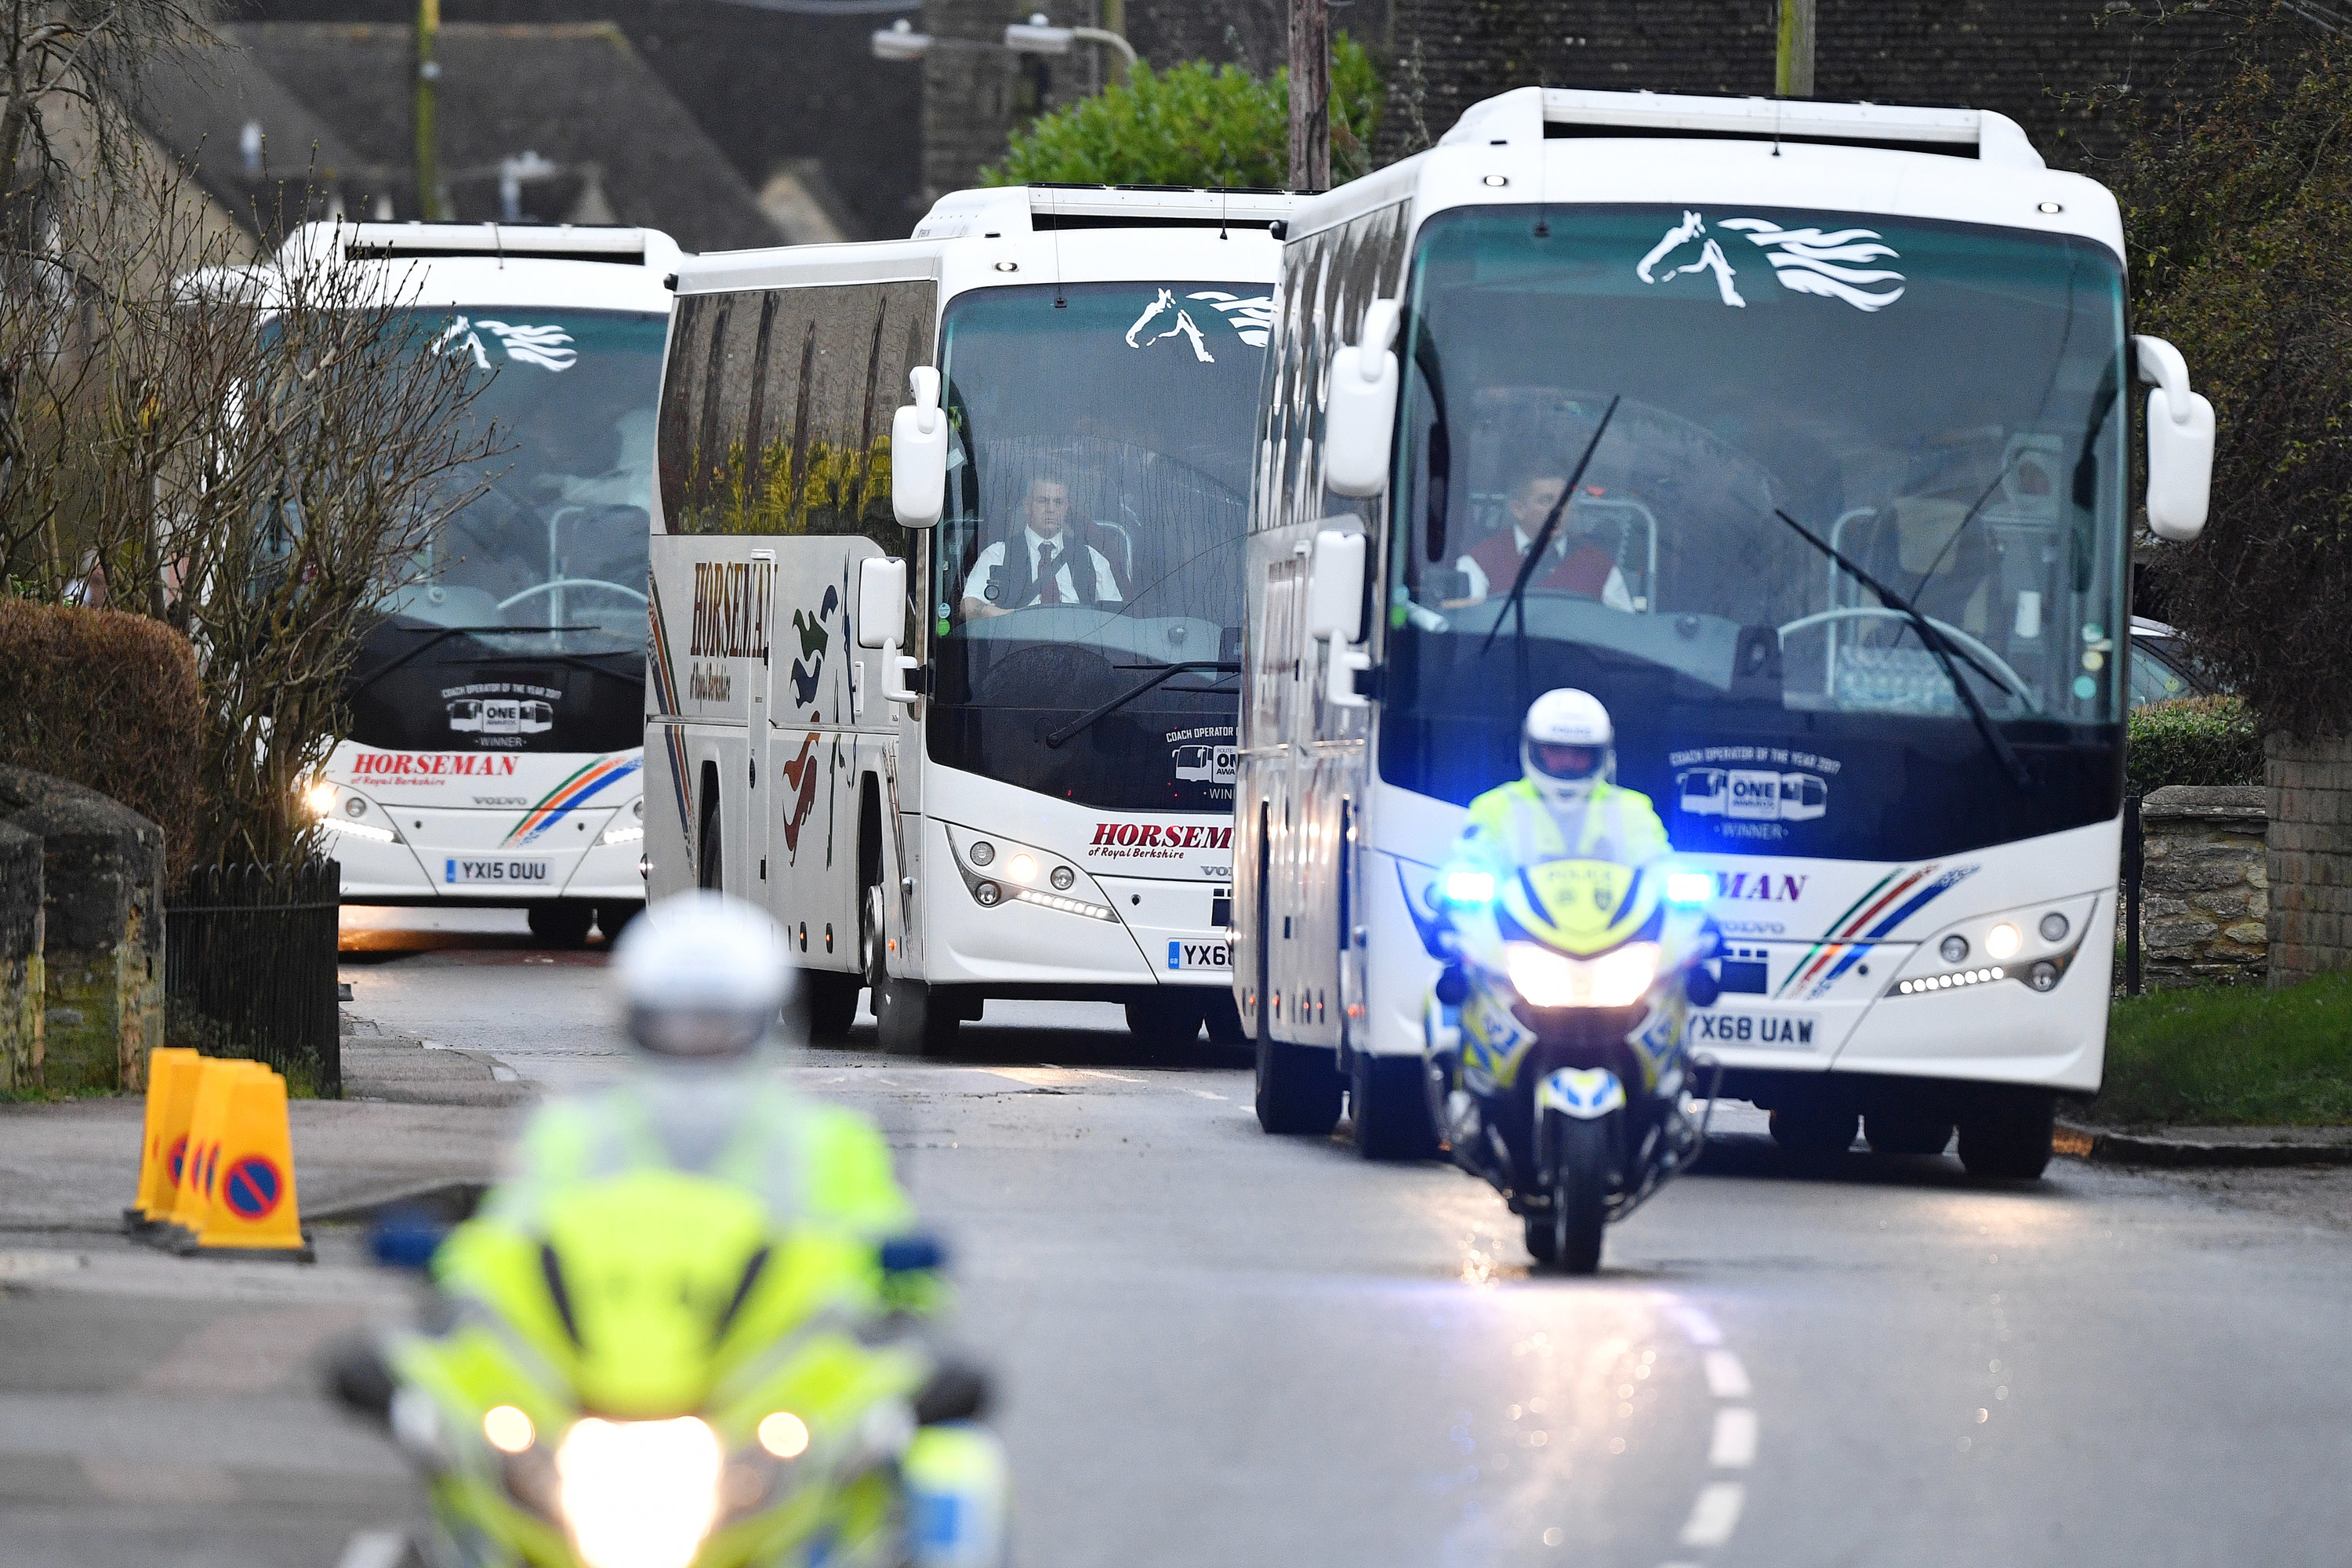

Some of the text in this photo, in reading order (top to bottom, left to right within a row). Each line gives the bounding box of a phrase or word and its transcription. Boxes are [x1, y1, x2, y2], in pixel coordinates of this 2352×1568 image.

[442, 686, 466, 698] COACH
[466, 684, 500, 695] OPERATOR
[502, 683, 510, 692] OF
[513, 684, 524, 693] THE
[527, 685, 545, 695] YEAR
[487, 707, 516, 718] ONE
[480, 737, 523, 747] WINNER
[1166, 729, 1192, 743] COACH
[1194, 727, 1233, 738] OPERATOR
[351, 753, 520, 776] HORSEMAN
[350, 776, 445, 786] of Royal Berkshire
[1209, 788, 1234, 800] WIN
[1733, 781, 1775, 797] ONE
[473, 796, 528, 805] VOLVO
[1090, 823, 1233, 849] HORSEM
[1723, 822, 1782, 840] WINNER
[1088, 848, 1185, 859] of Royal Berkshire
[463, 862, 546, 880] YX15 OUU
[1722, 921, 1785, 934] OLVO
[1762, 1018, 1813, 1042] UAW
